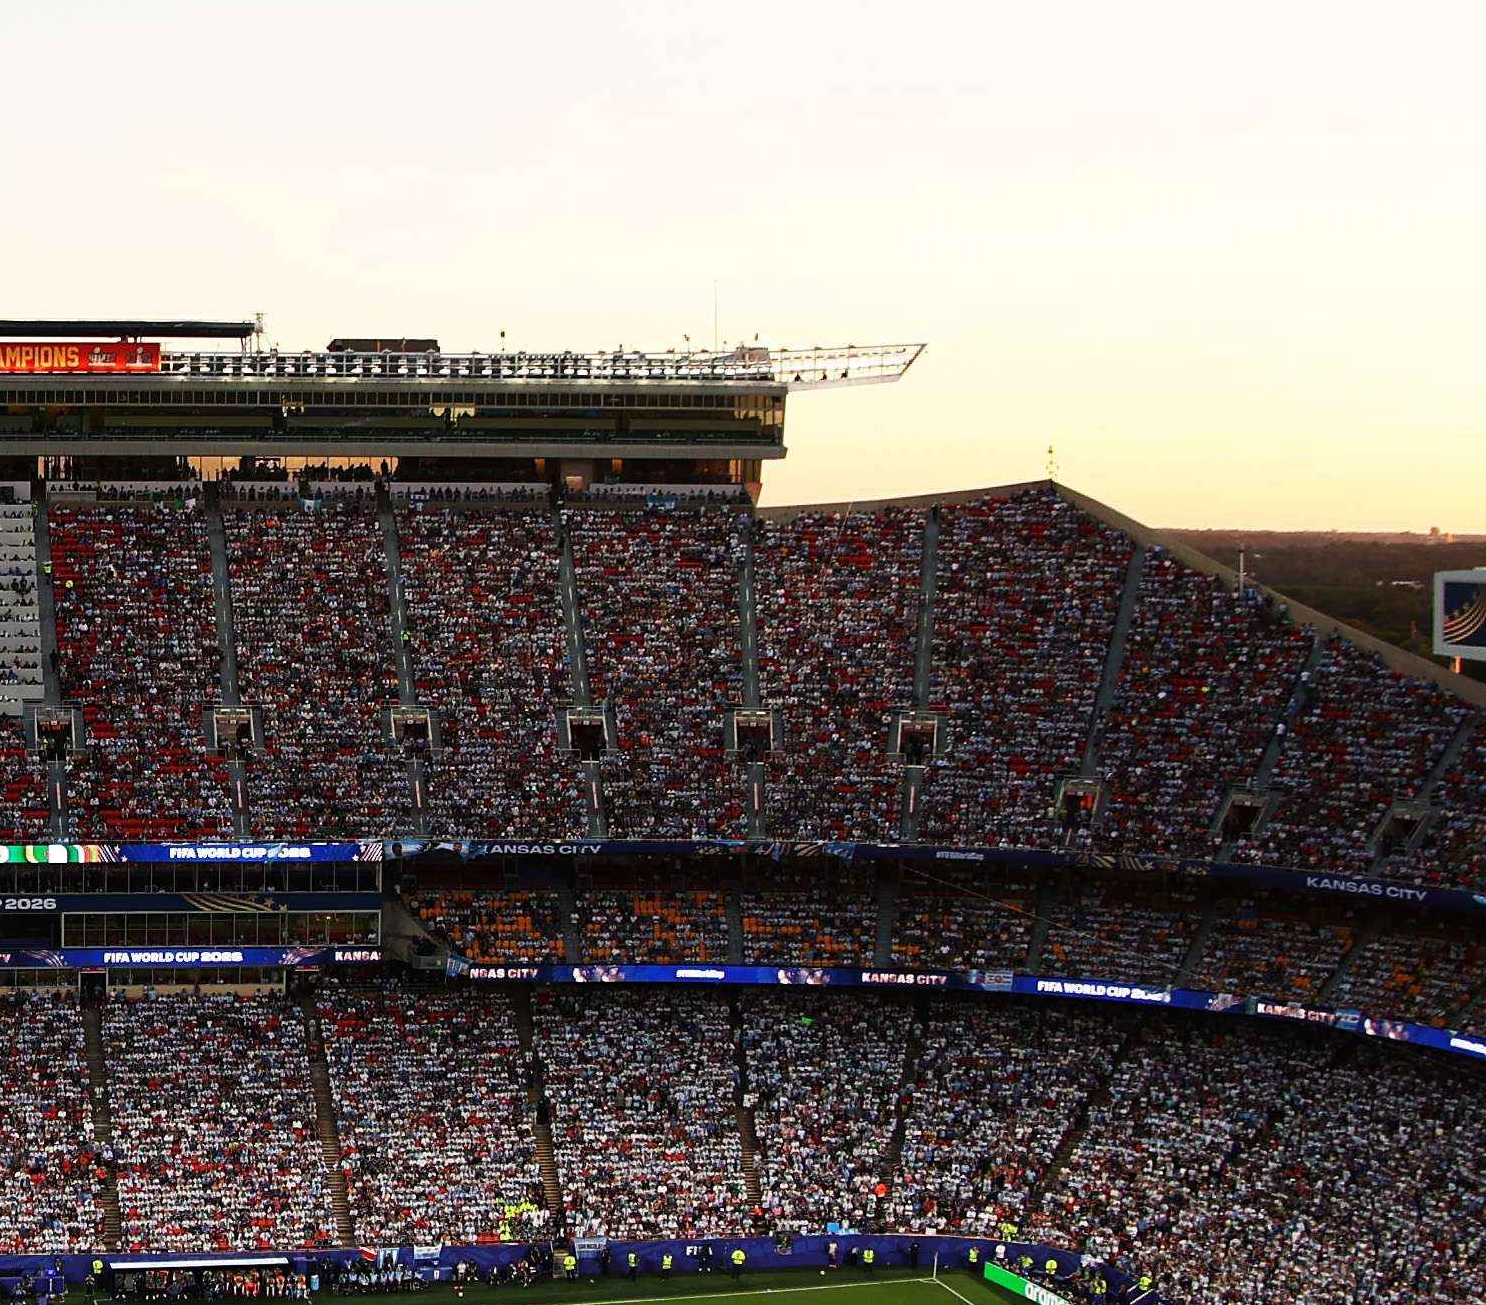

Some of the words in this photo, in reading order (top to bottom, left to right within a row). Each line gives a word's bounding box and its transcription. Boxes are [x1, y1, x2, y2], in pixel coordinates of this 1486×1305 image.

[170, 848, 194, 859] FIFA
[196, 847, 242, 858] WORLD
[245, 847, 266, 858] CUP
[1307, 876, 1382, 894] KANSAS
[1386, 887, 1427, 900] CITY
[4, 898, 57, 910] 2026
[103, 952, 128, 963] FIFA
[130, 952, 176, 963] WORLD
[178, 952, 199, 963] CUP
[470, 968, 505, 978] NSAS
[508, 968, 538, 978] CITY
[862, 972, 914, 984] KANSAS
[917, 974, 947, 985] CITY
[1038, 980, 1062, 992] FIFA
[1064, 982, 1105, 996] WORLD
[1107, 985, 1129, 998] CUP
